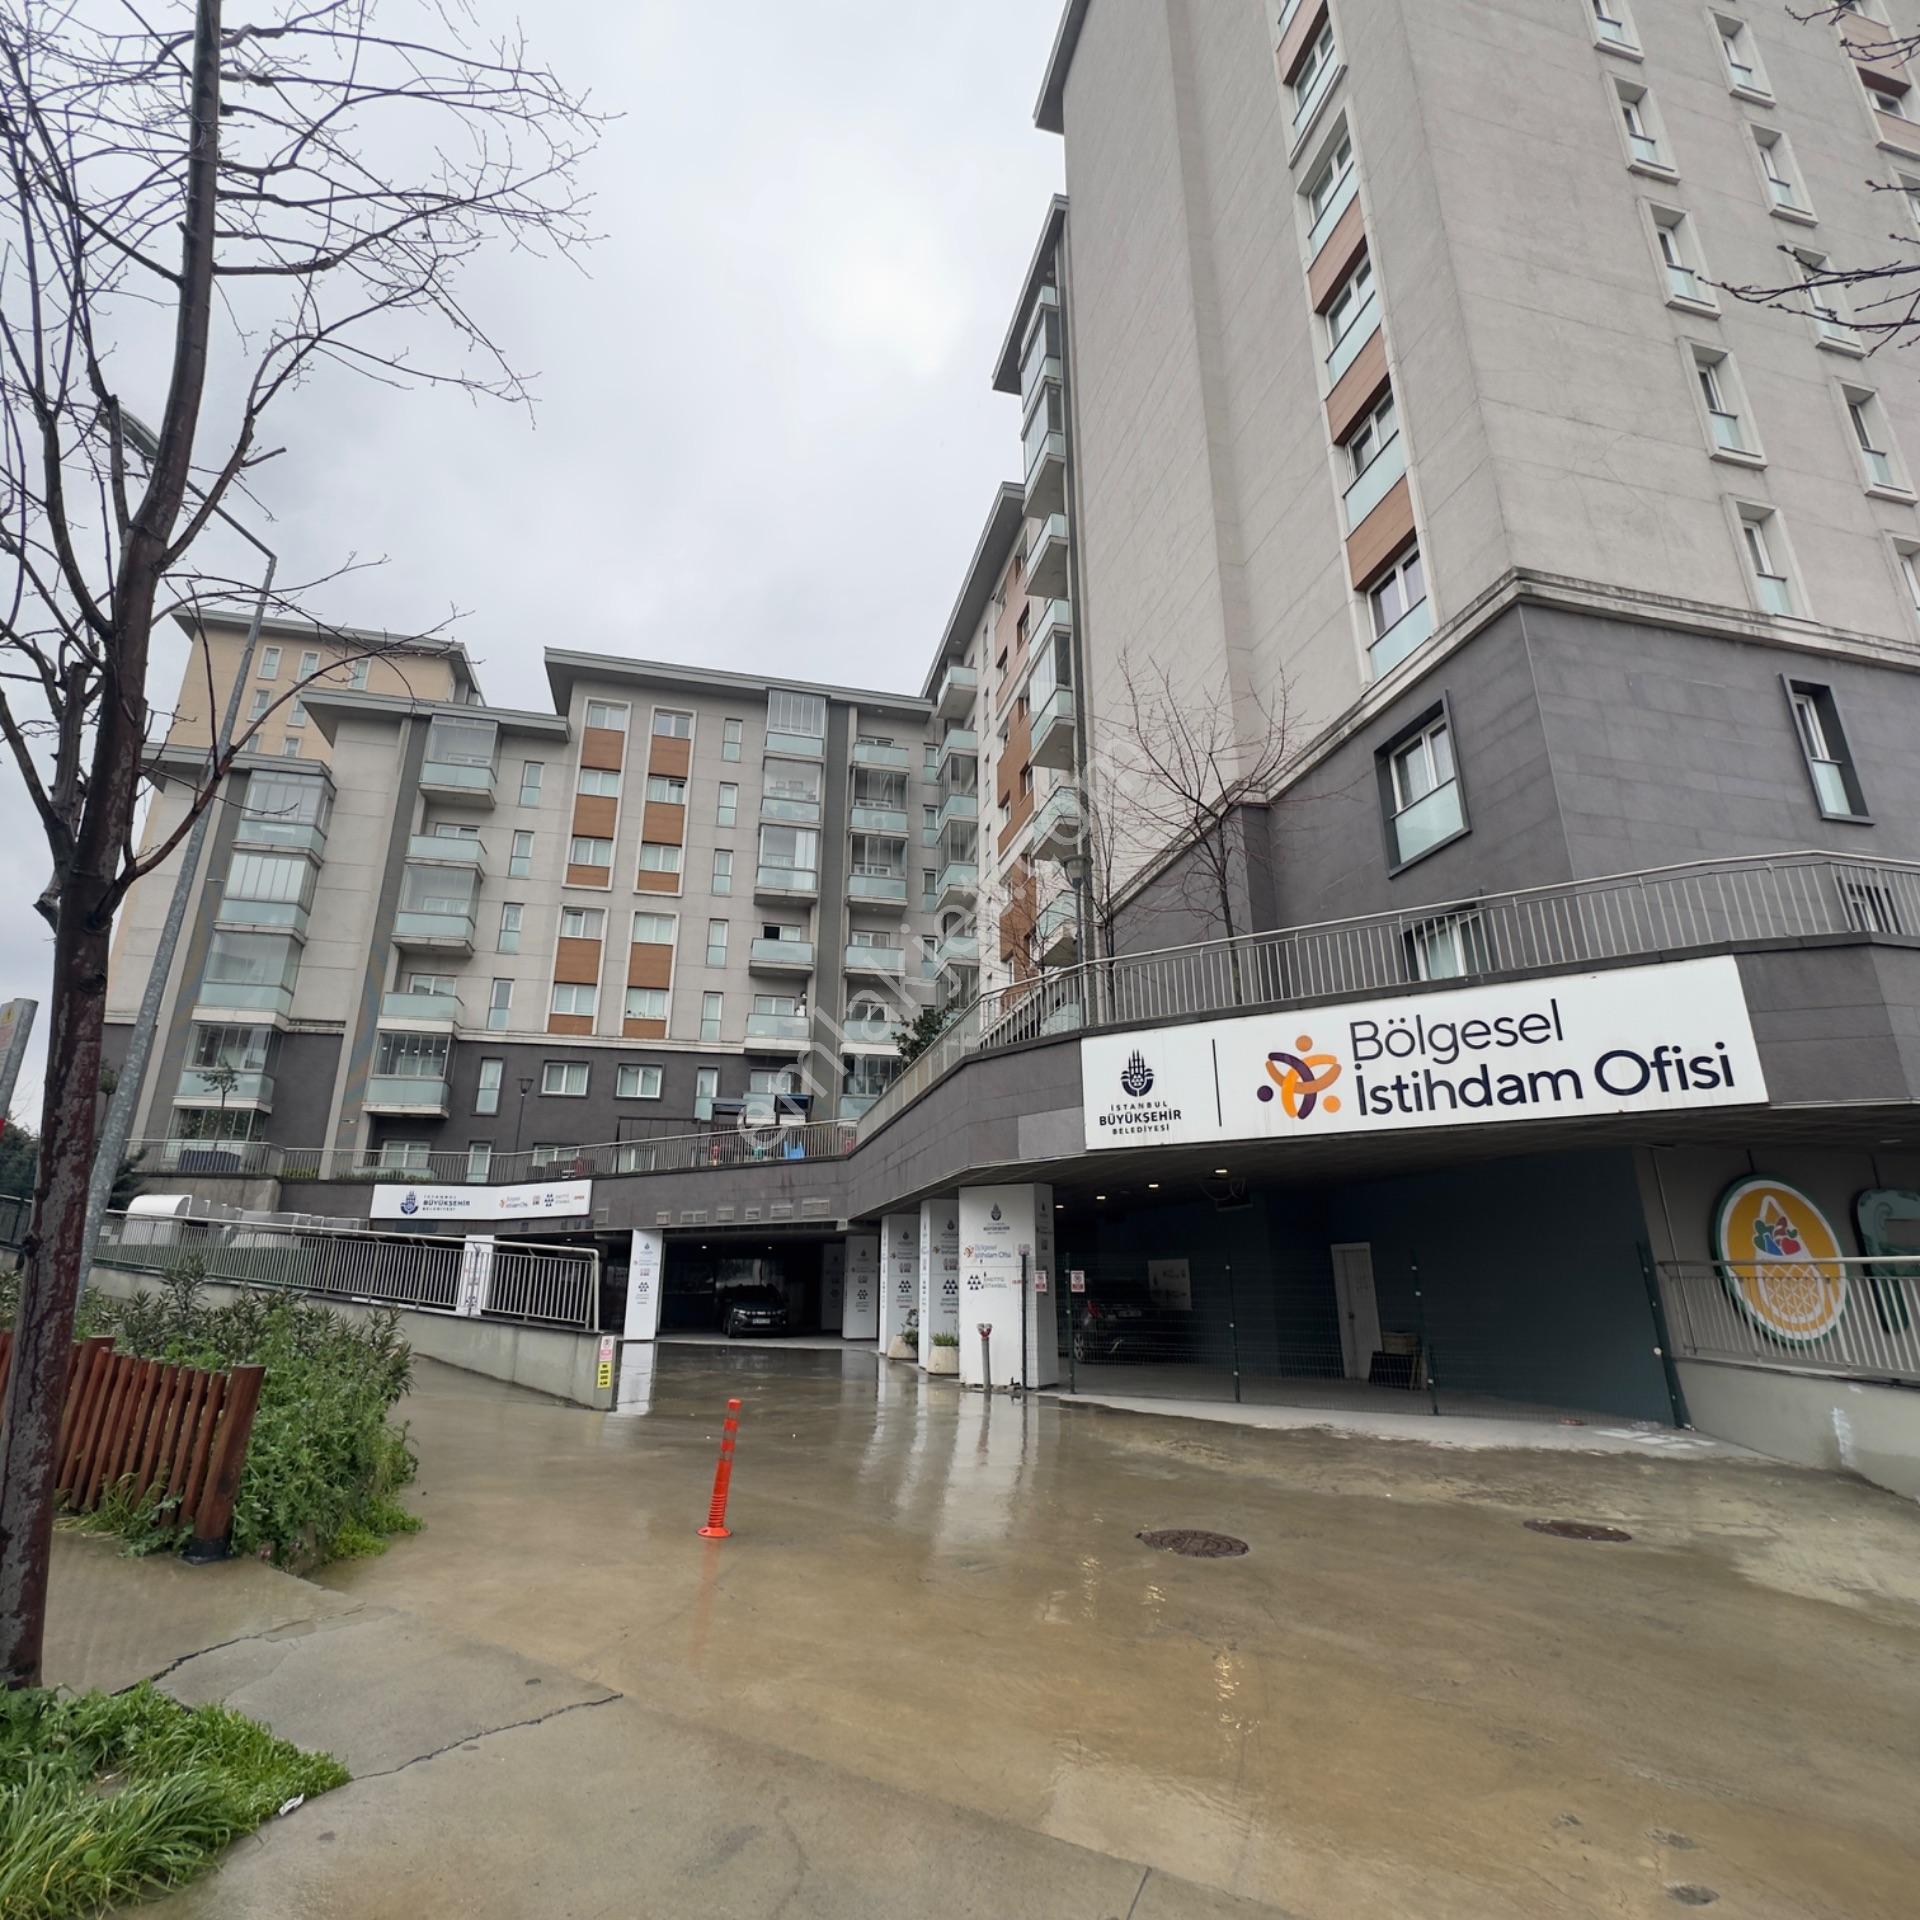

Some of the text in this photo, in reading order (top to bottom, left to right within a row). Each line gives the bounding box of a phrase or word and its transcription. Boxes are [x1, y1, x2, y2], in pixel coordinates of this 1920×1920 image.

[1349, 998, 1564, 1065] Bölgesel
[1353, 1041, 1735, 1116] İstihdam Ofisi
[1110, 1100, 1168, 1112] İSTANBUL
[1099, 1109, 1182, 1126] BÜYÜKŞEHİR
[1112, 1123, 1170, 1135] BELEDİYESİ
